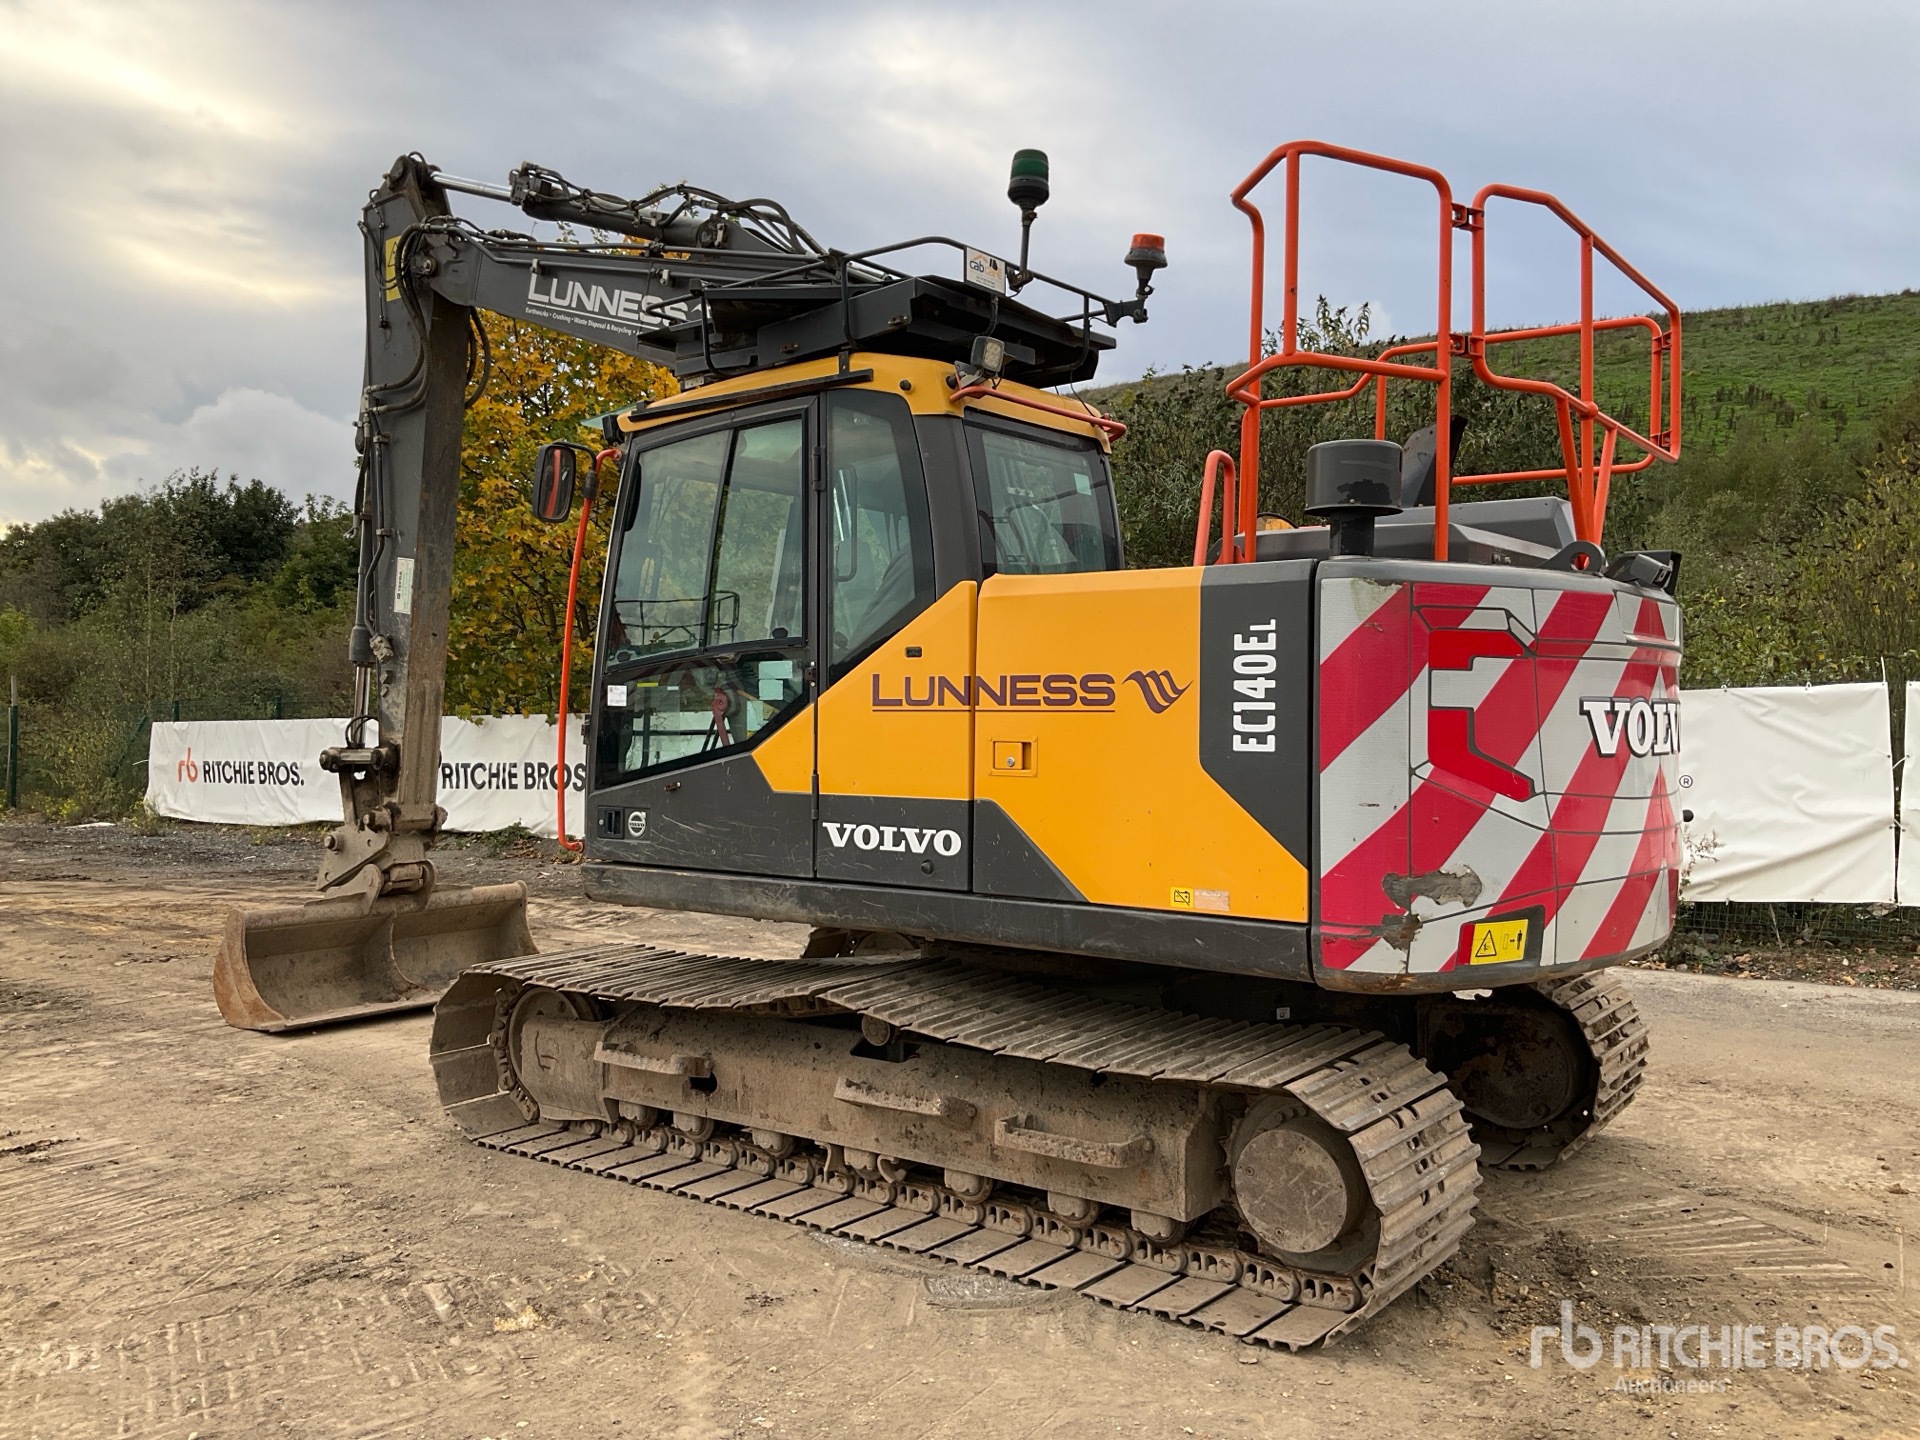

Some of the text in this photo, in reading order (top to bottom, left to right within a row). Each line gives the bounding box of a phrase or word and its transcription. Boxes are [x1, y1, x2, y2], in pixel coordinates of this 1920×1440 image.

[528, 273, 689, 326] LUNNESS
[525, 307, 549, 317] Earthworks
[552, 312, 571, 323] Crushing
[574, 317, 587, 326] Waste
[587, 319, 607, 330] Disposal
[611, 324, 632, 336] Recycling
[872, 674, 1116, 706] LUNNESS
[1580, 697, 1680, 758] VOLV
[203, 761, 255, 784] RITCHIE
[258, 761, 304, 786] BROS.
[441, 762, 518, 790] RITCHIE
[822, 822, 962, 857] VOLVO
